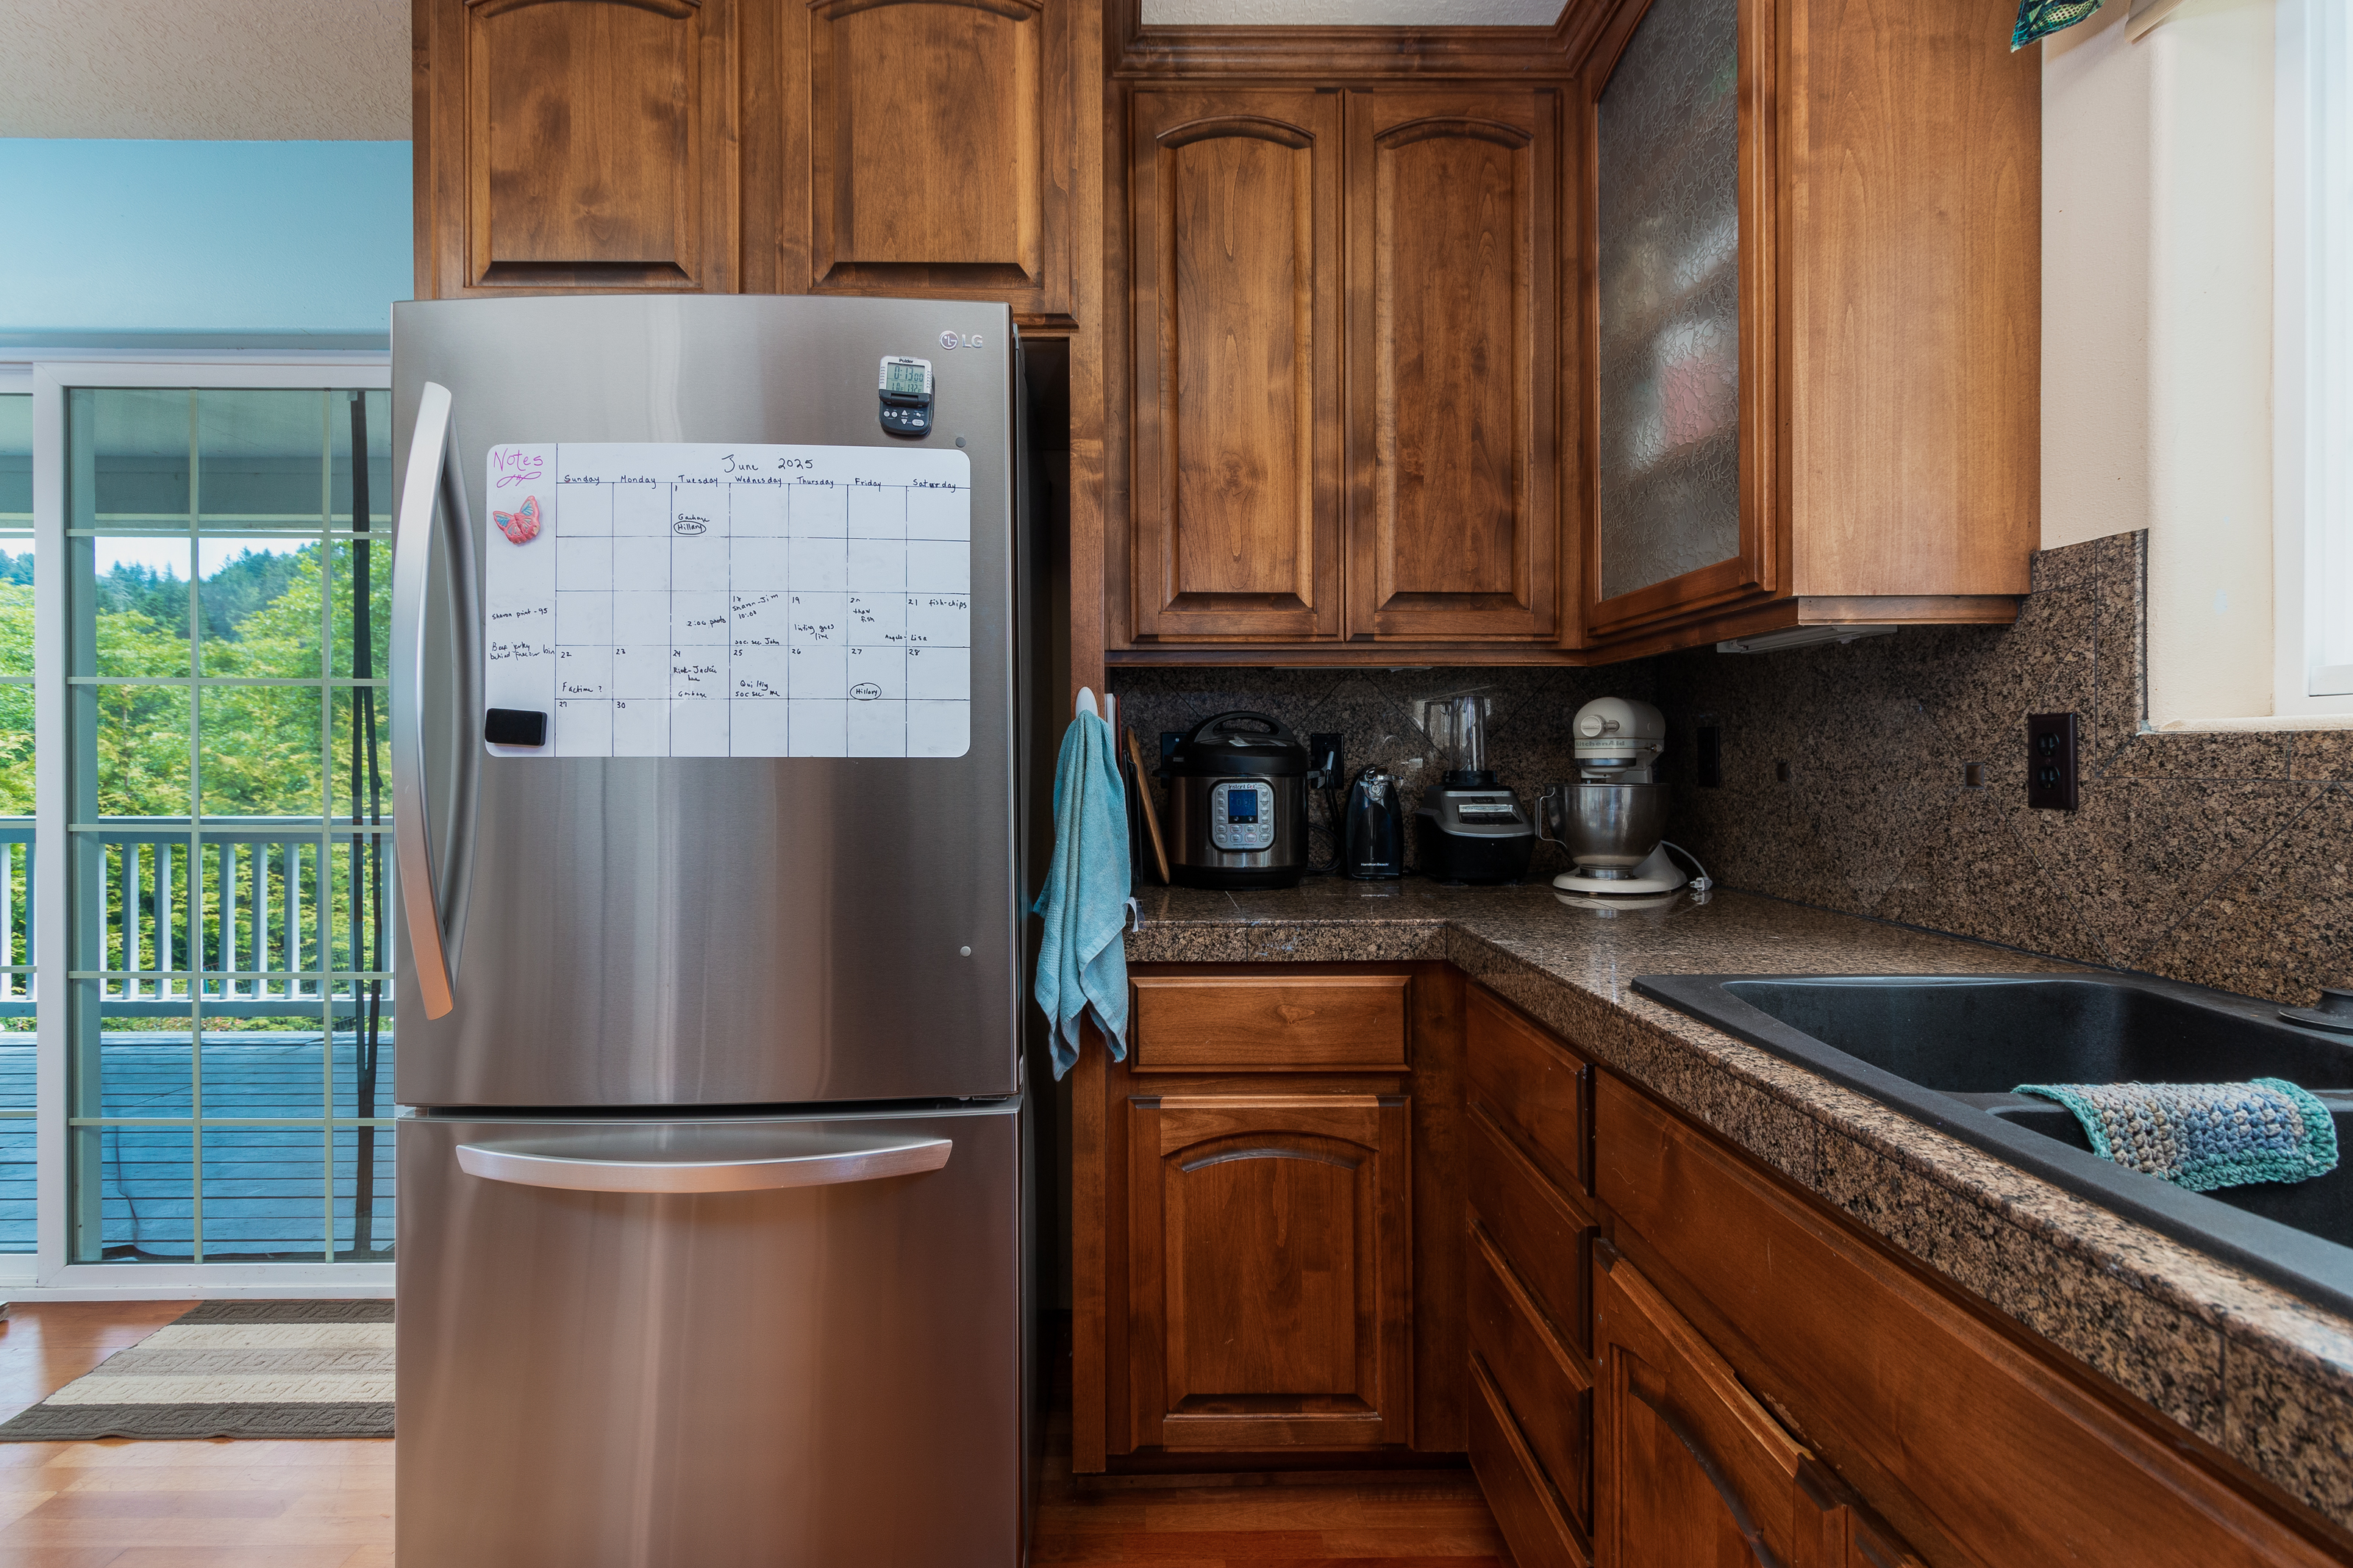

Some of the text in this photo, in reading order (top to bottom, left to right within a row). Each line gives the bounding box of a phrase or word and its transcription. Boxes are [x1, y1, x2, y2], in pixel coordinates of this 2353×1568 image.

[962, 334, 983, 348] LG
[493, 448, 543, 471] Notes
[721, 454, 813, 473] June 2025
[564, 474, 600, 486] Sunday
[621, 475, 657, 489] Monday
[678, 474, 718, 488] Tuesday
[735, 475, 782, 488] Wednesday
[796, 476, 834, 489] Thursday
[854, 478, 882, 493] Friday
[913, 479, 956, 493] Saturday
[677, 523, 703, 532] Hillary
[792, 596, 801, 604] 19
[908, 598, 918, 606] 21
[516, 609, 531, 618] print
[738, 610, 757, 620] 10:00
[710, 615, 726, 628] photo
[819, 623, 835, 633] goes
[492, 641, 530, 653] Beef jerky
[765, 637, 780, 645] John
[490, 651, 510, 660] behind
[543, 644, 555, 654] bin
[672, 649, 681, 657] 24
[909, 648, 921, 656] 28
[855, 687, 878, 697] Hillary
